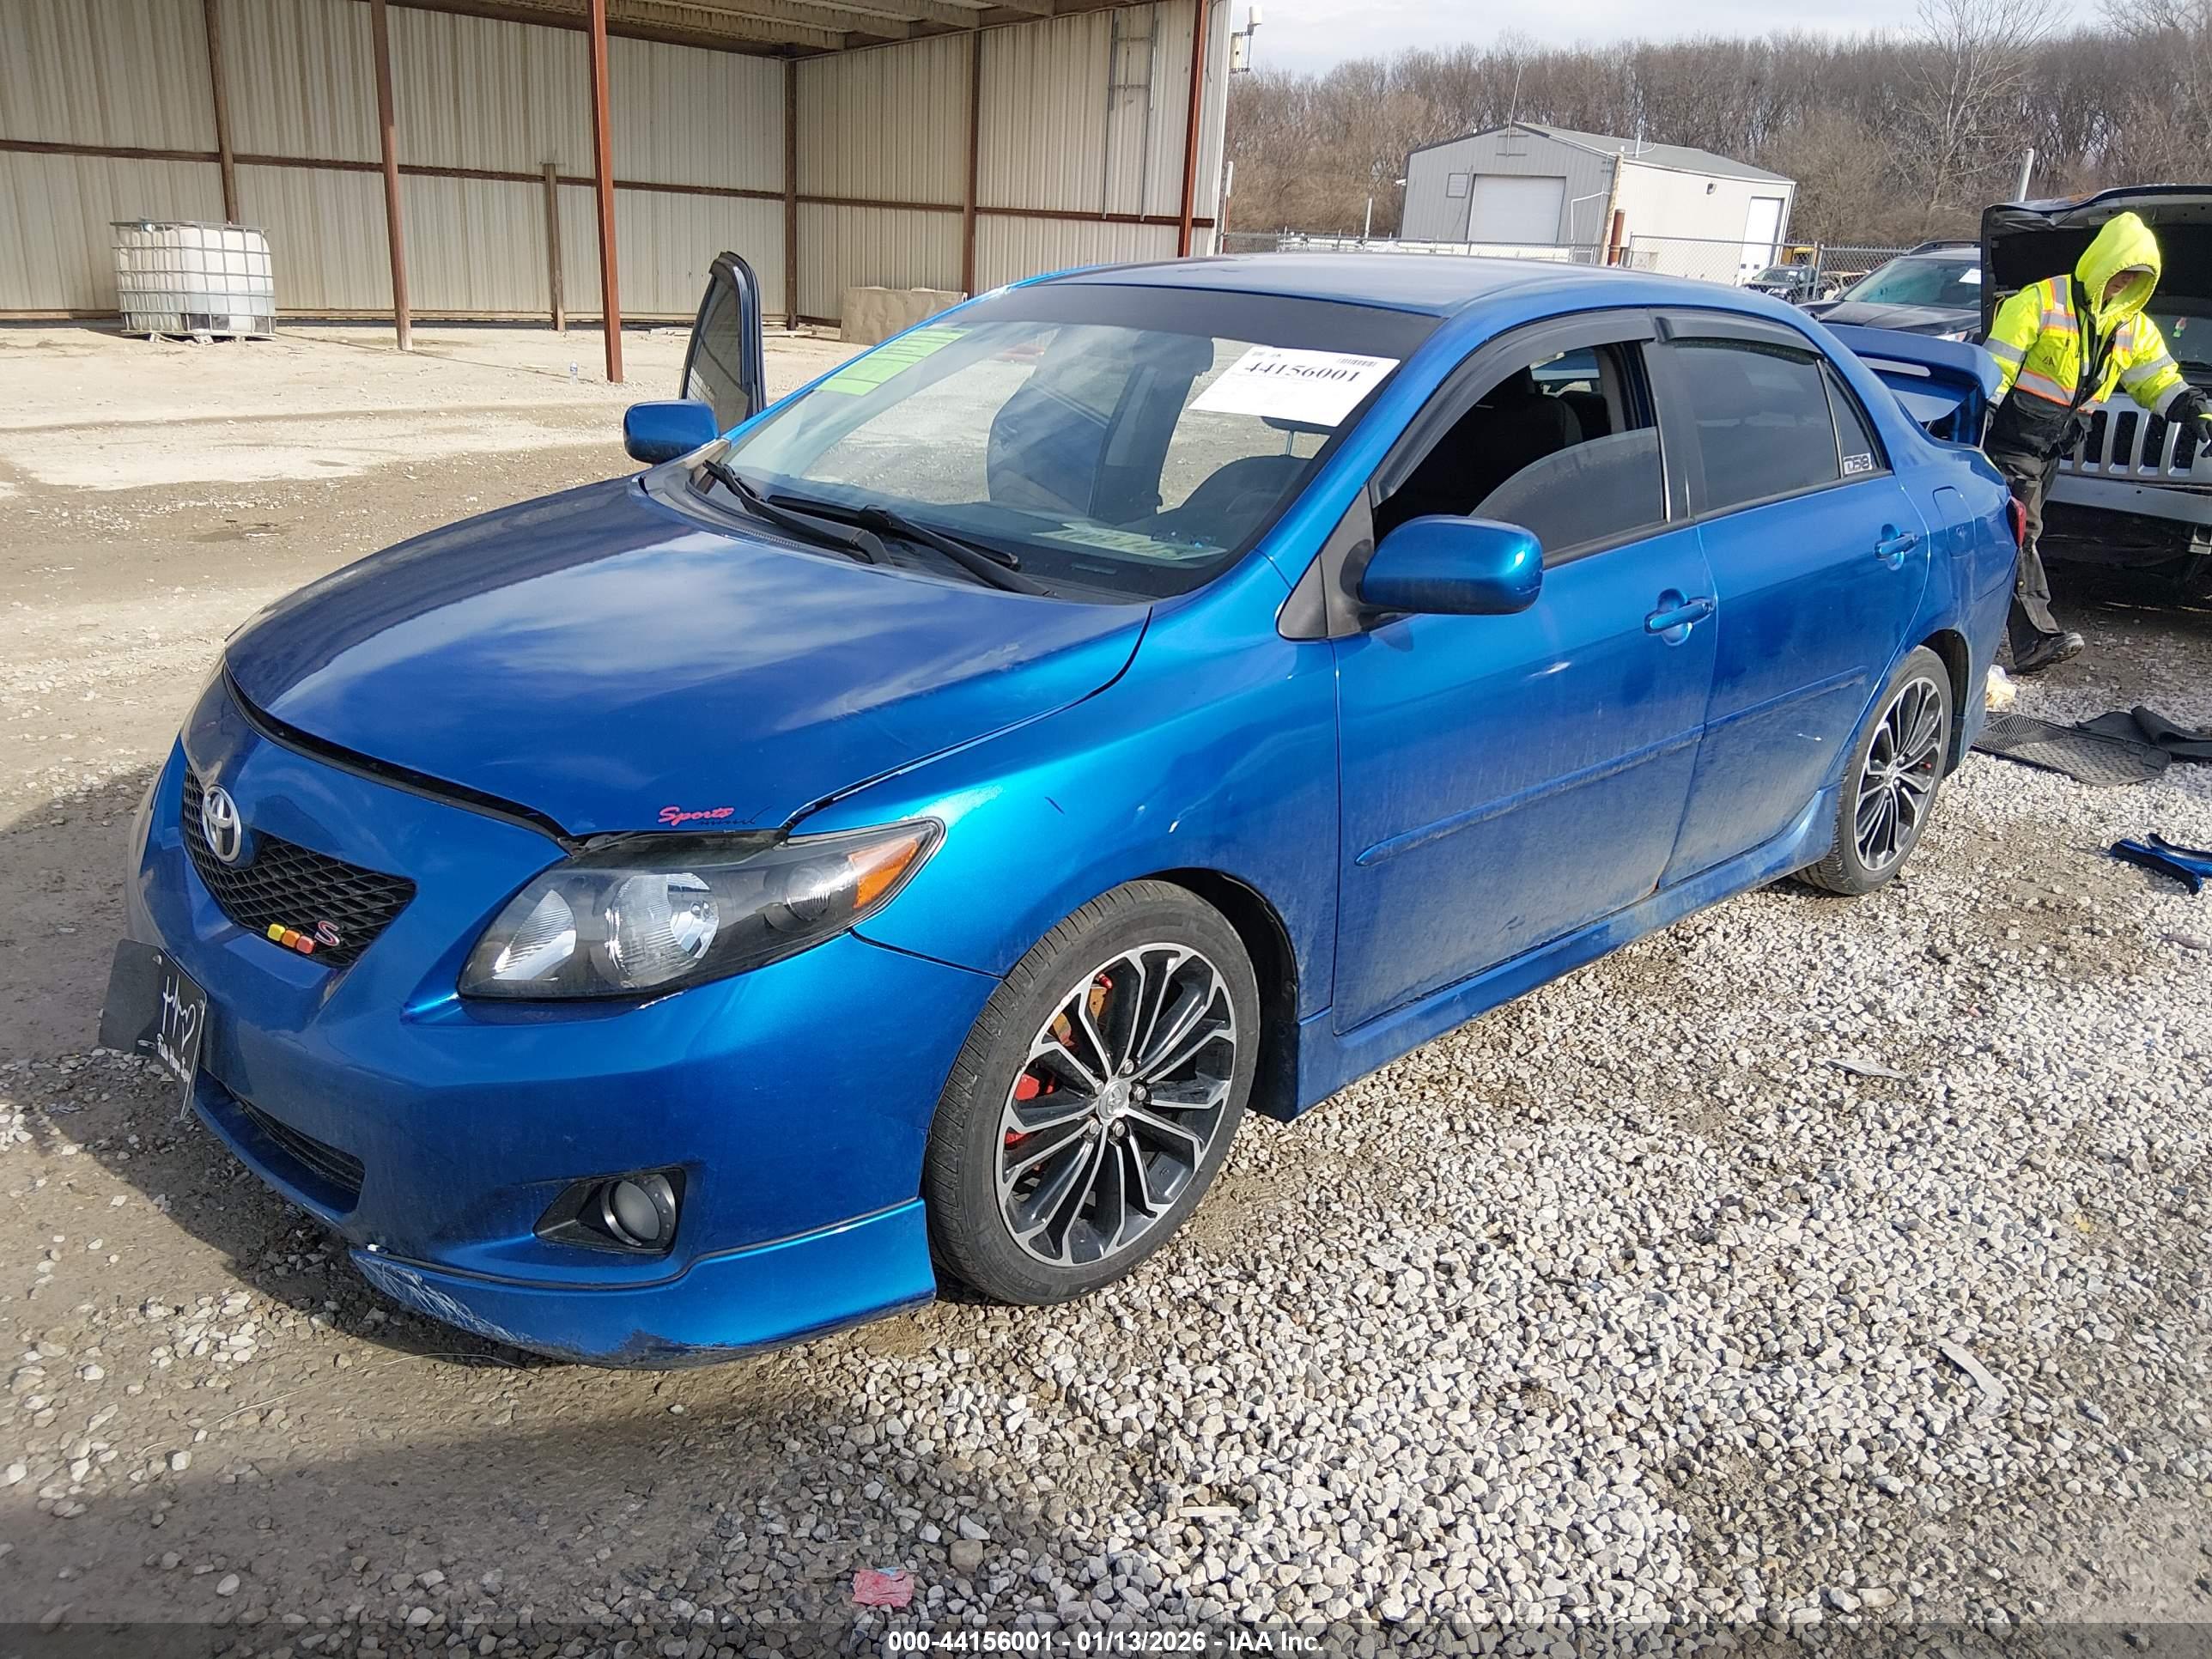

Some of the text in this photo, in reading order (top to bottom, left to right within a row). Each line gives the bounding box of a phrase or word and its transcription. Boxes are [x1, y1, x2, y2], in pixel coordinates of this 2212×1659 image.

[1244, 362, 1361, 382] 44156001
[658, 806, 734, 826] Sports
[314, 920, 340, 946] S
